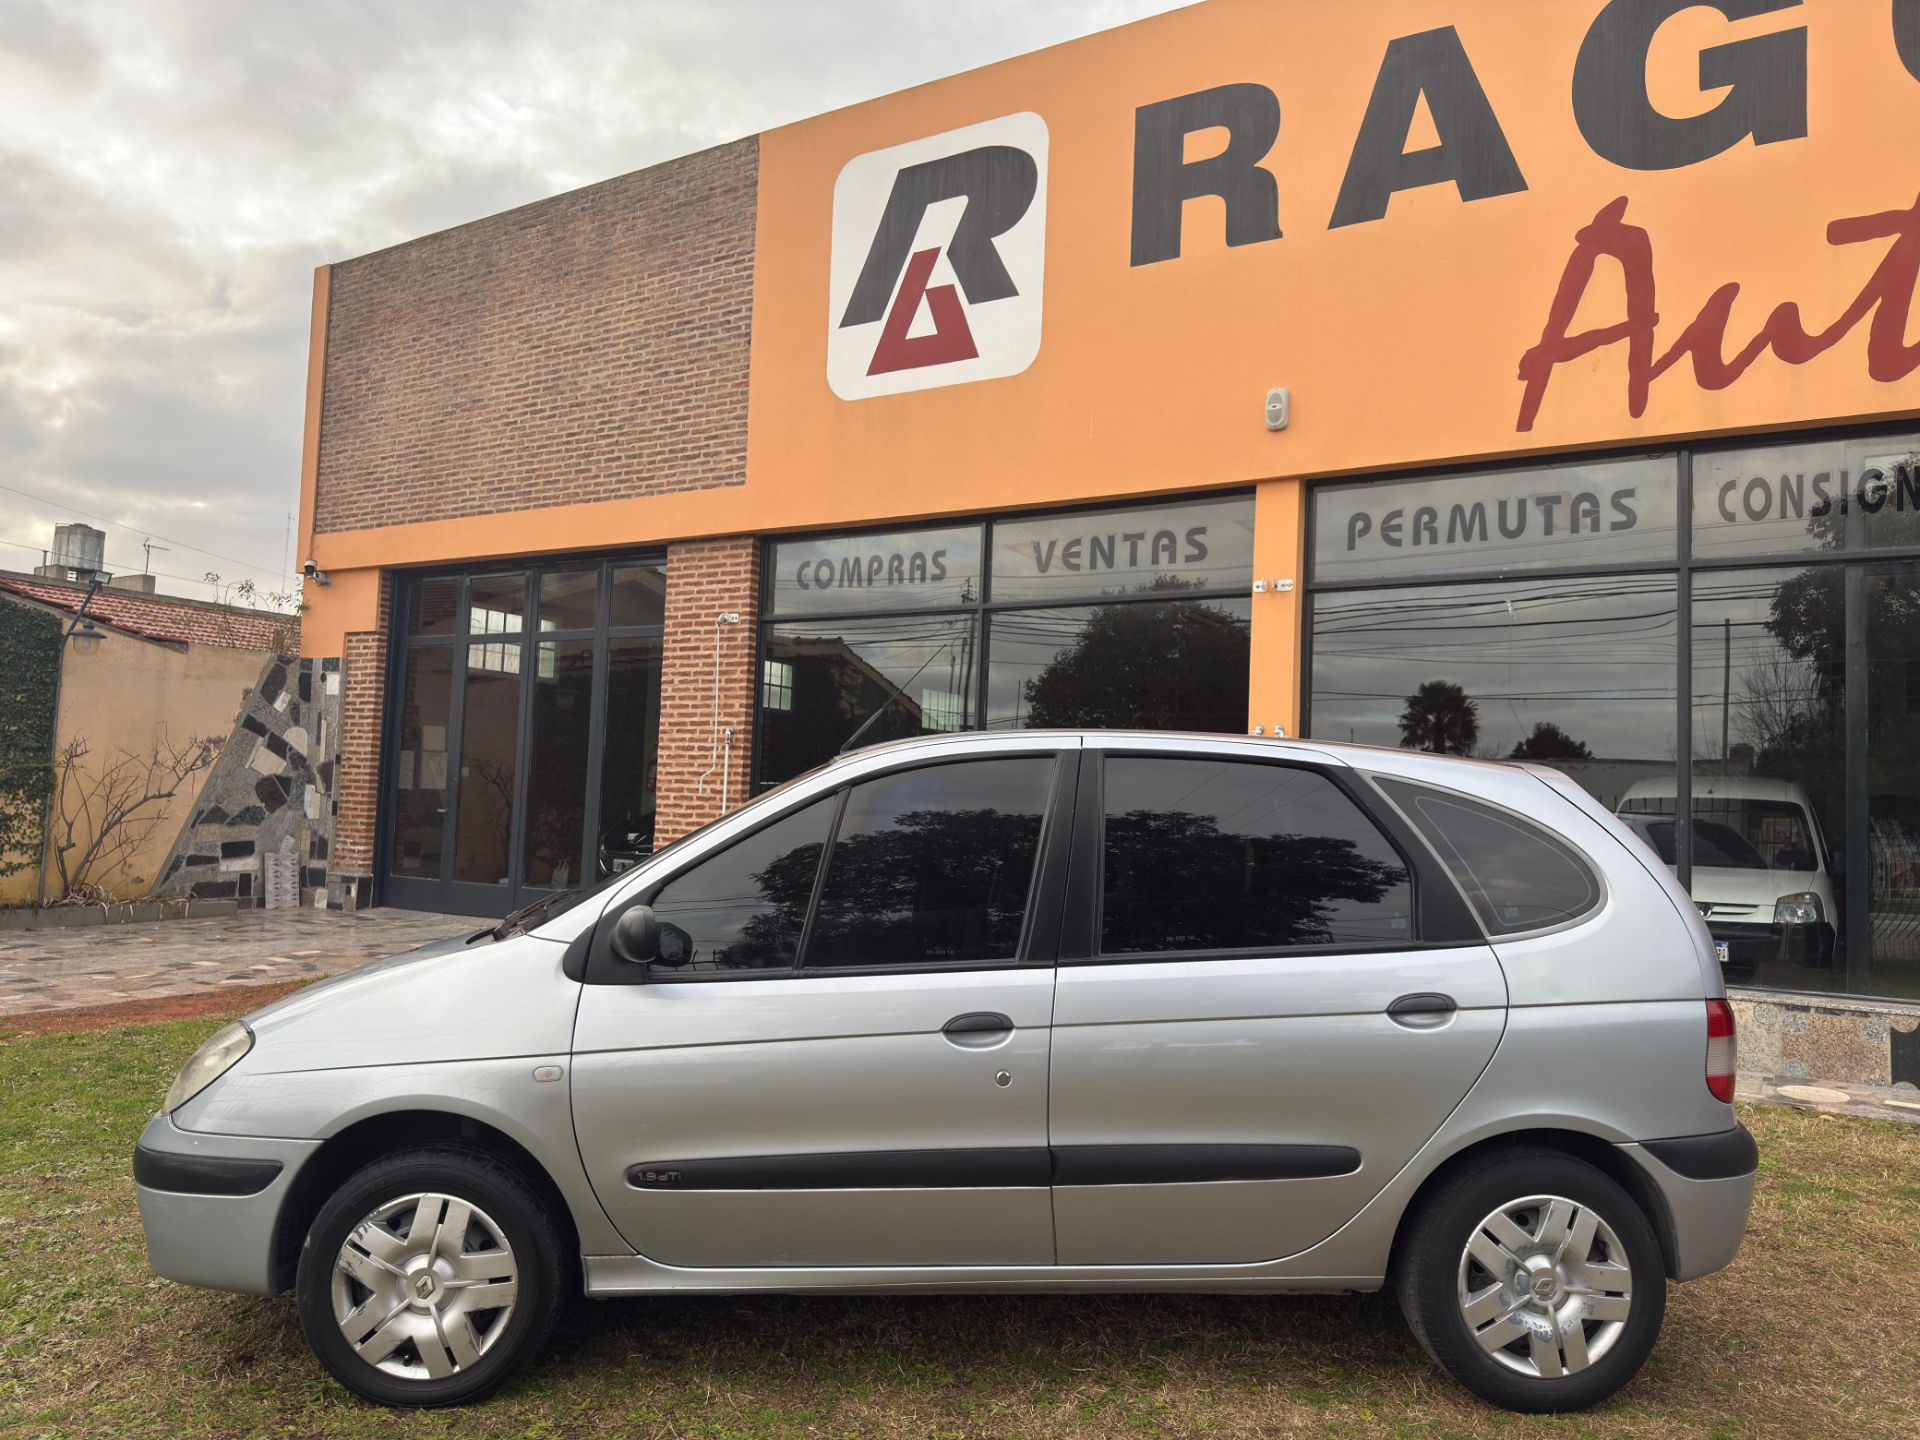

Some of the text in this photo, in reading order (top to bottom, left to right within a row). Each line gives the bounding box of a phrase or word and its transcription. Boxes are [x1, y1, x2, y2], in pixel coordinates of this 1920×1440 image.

[1130, 0, 1920, 267] RAG
[1347, 488, 1638, 551] PERMUTAS
[1718, 465, 1920, 523] CONSIGN
[797, 549, 947, 590] COMPRAS
[1031, 526, 1208, 573] VENTAS
